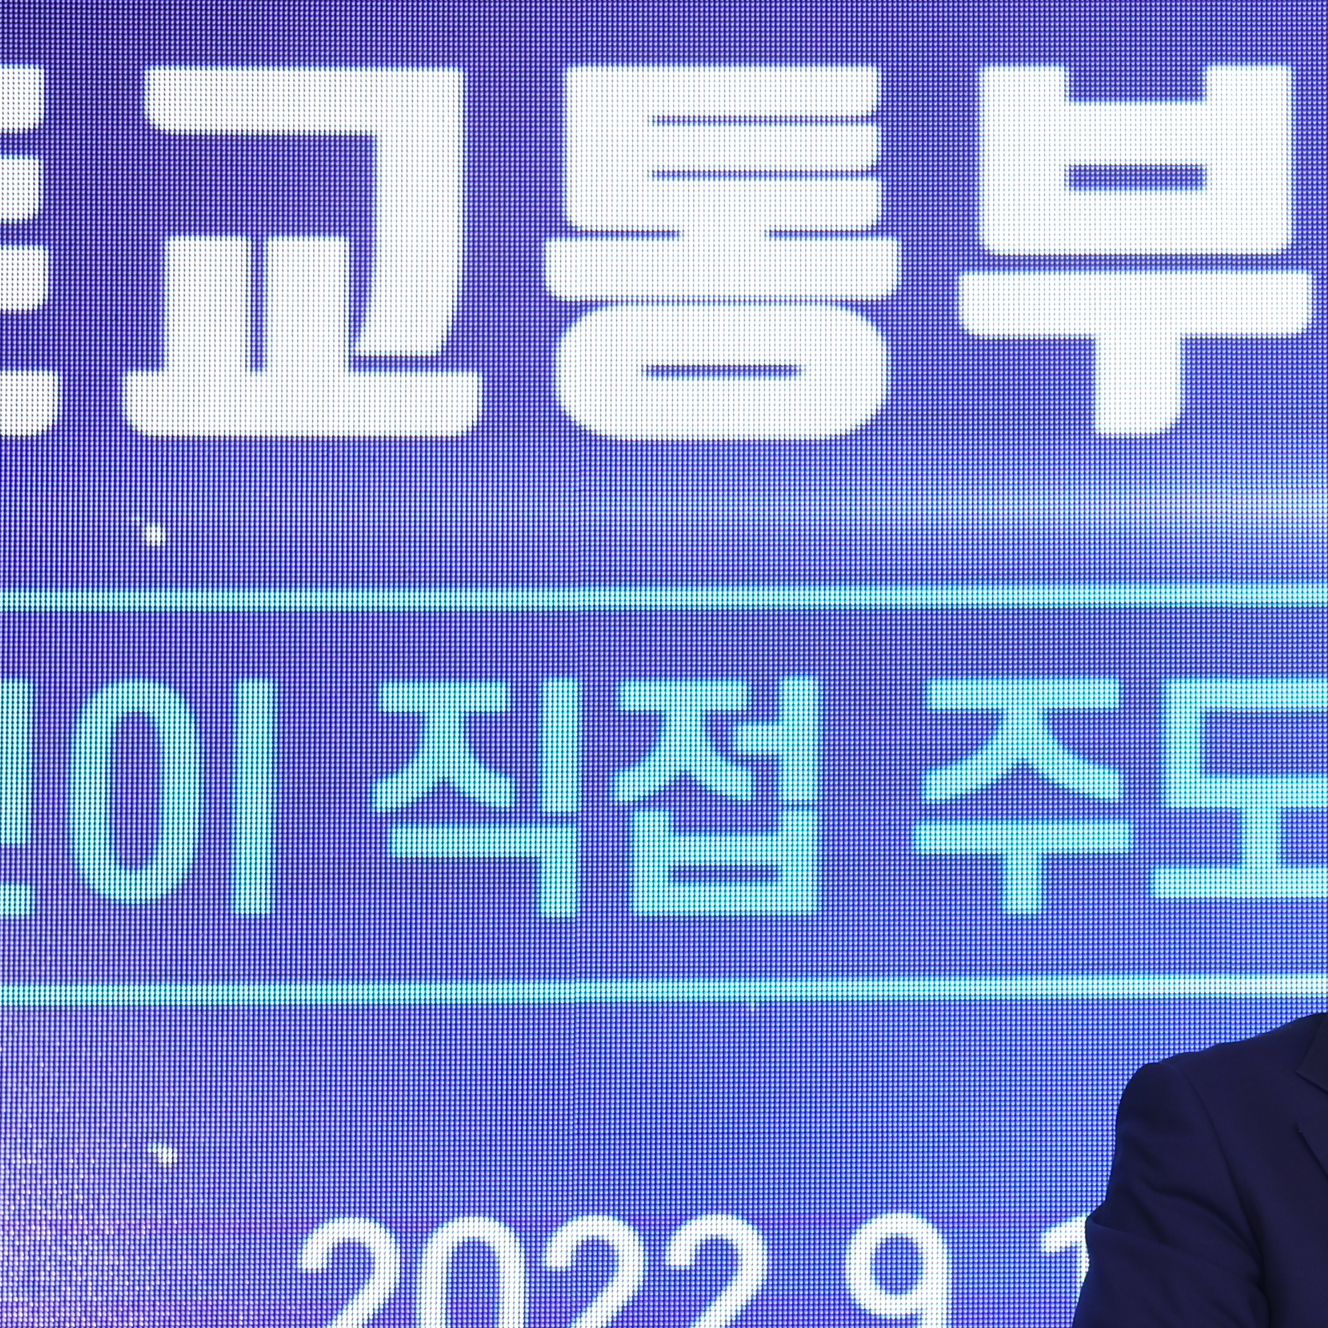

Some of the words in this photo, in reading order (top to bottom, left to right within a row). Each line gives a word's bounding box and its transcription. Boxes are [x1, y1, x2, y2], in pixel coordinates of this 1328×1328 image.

[0, 64, 1313, 441] 교통부
[0, 677, 278, 918] 이
[369, 676, 822, 918] 직접
